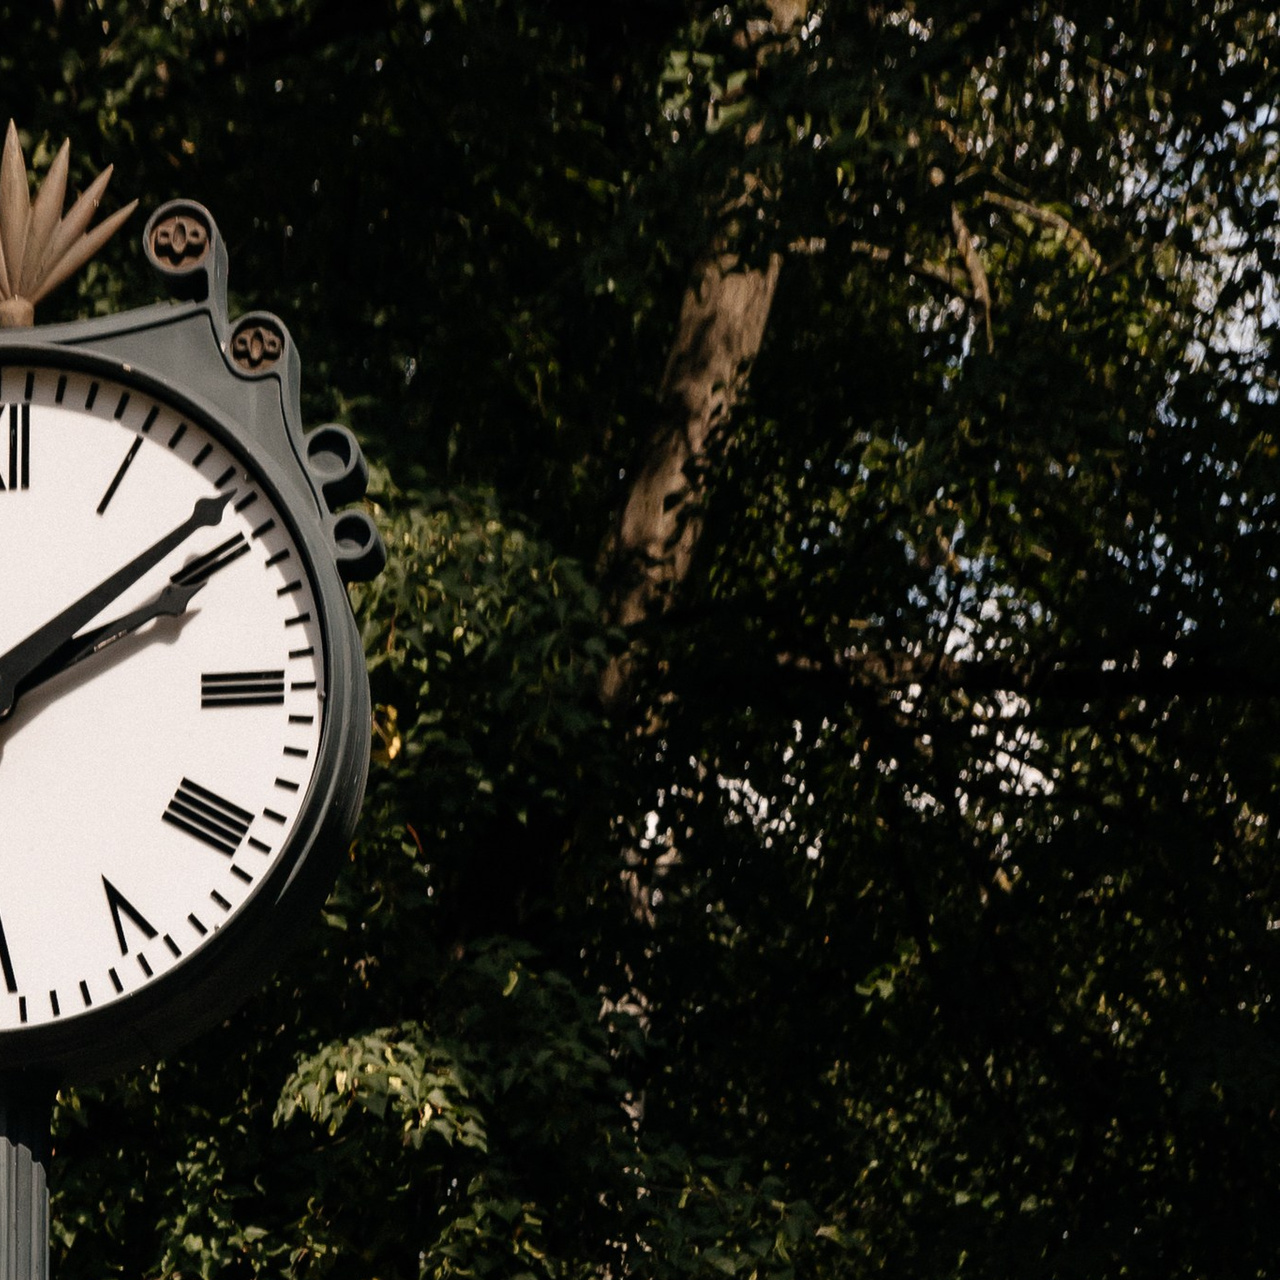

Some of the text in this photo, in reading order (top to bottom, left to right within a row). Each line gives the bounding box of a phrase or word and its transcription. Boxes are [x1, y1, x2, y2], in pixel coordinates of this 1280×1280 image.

[96, 434, 144, 516] I
[170, 531, 251, 587] II
[200, 669, 285, 709] III
[161, 776, 256, 858] IIII
[101, 873, 159, 957] V
